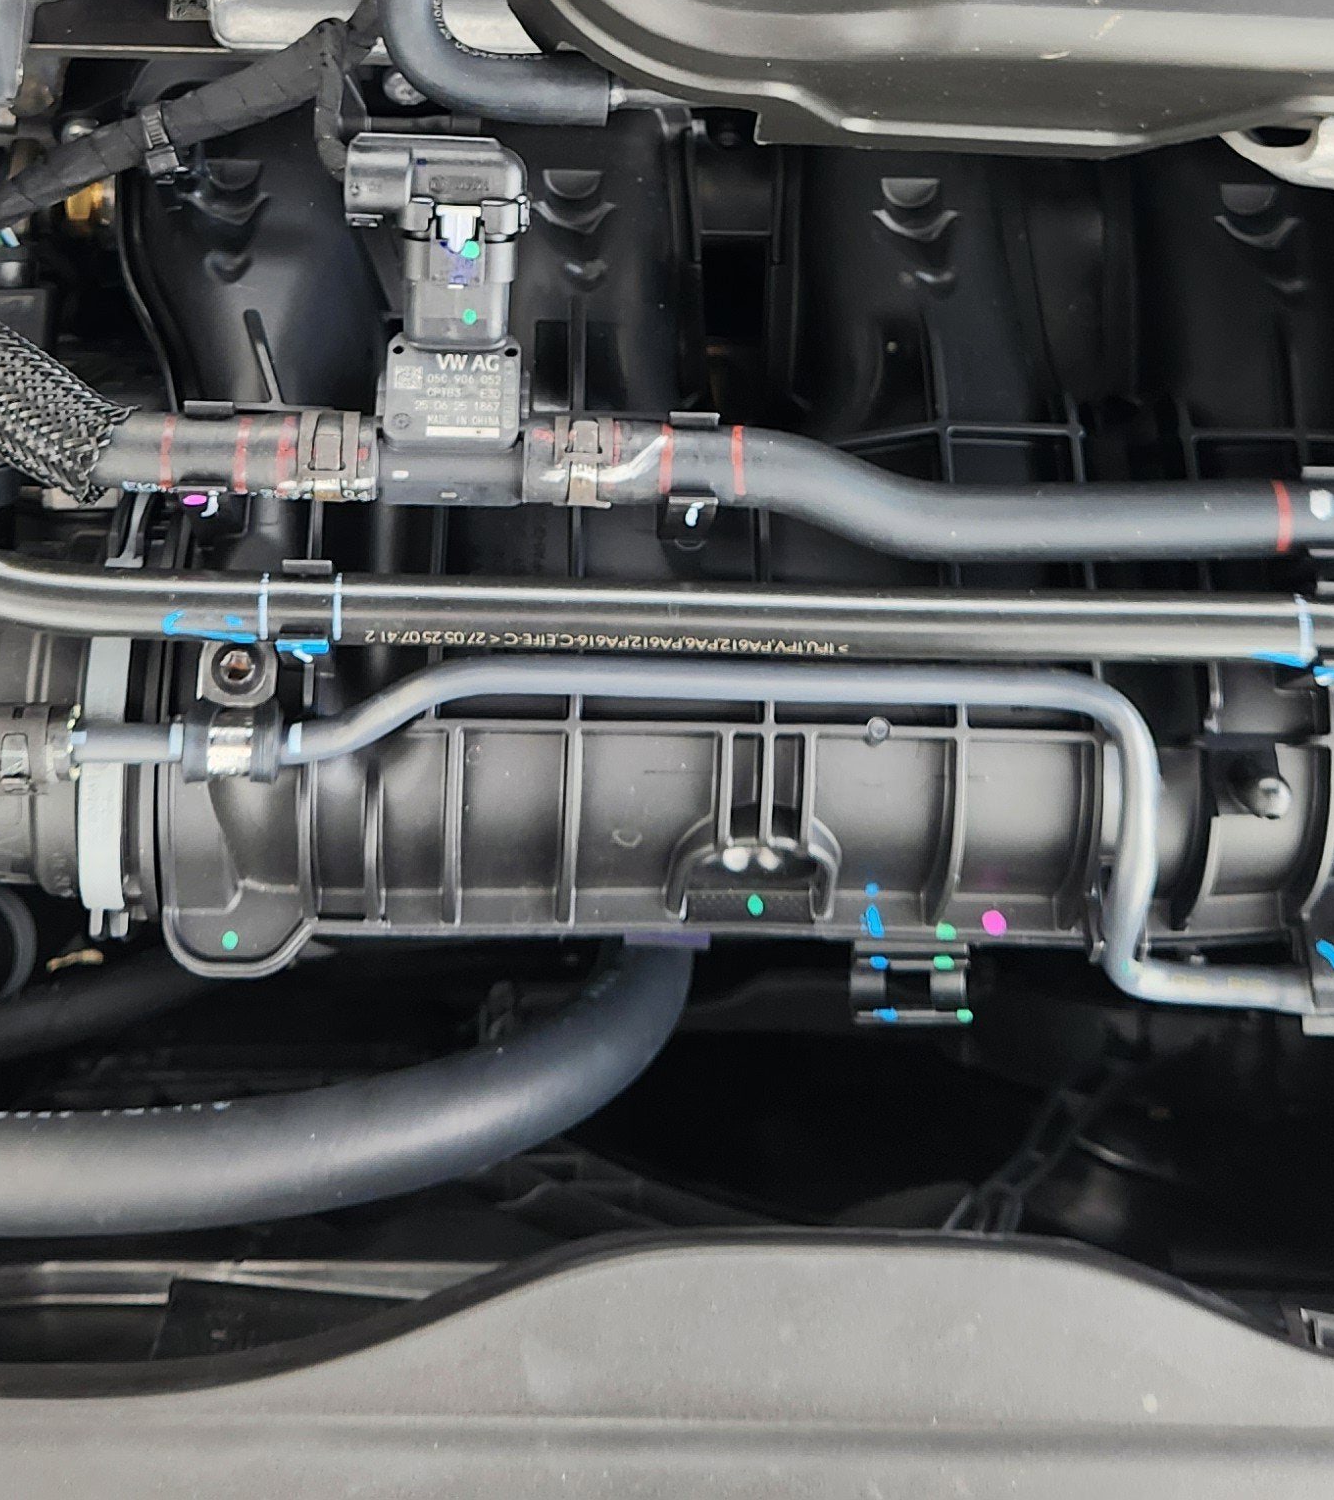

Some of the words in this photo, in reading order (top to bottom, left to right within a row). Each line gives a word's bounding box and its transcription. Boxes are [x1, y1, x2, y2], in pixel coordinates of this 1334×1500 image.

[435, 353, 469, 371] VW
[470, 354, 500, 372] AG
[427, 414, 450, 425] MADE
[456, 415, 468, 425] IN
[471, 415, 500, 426] CHINA
